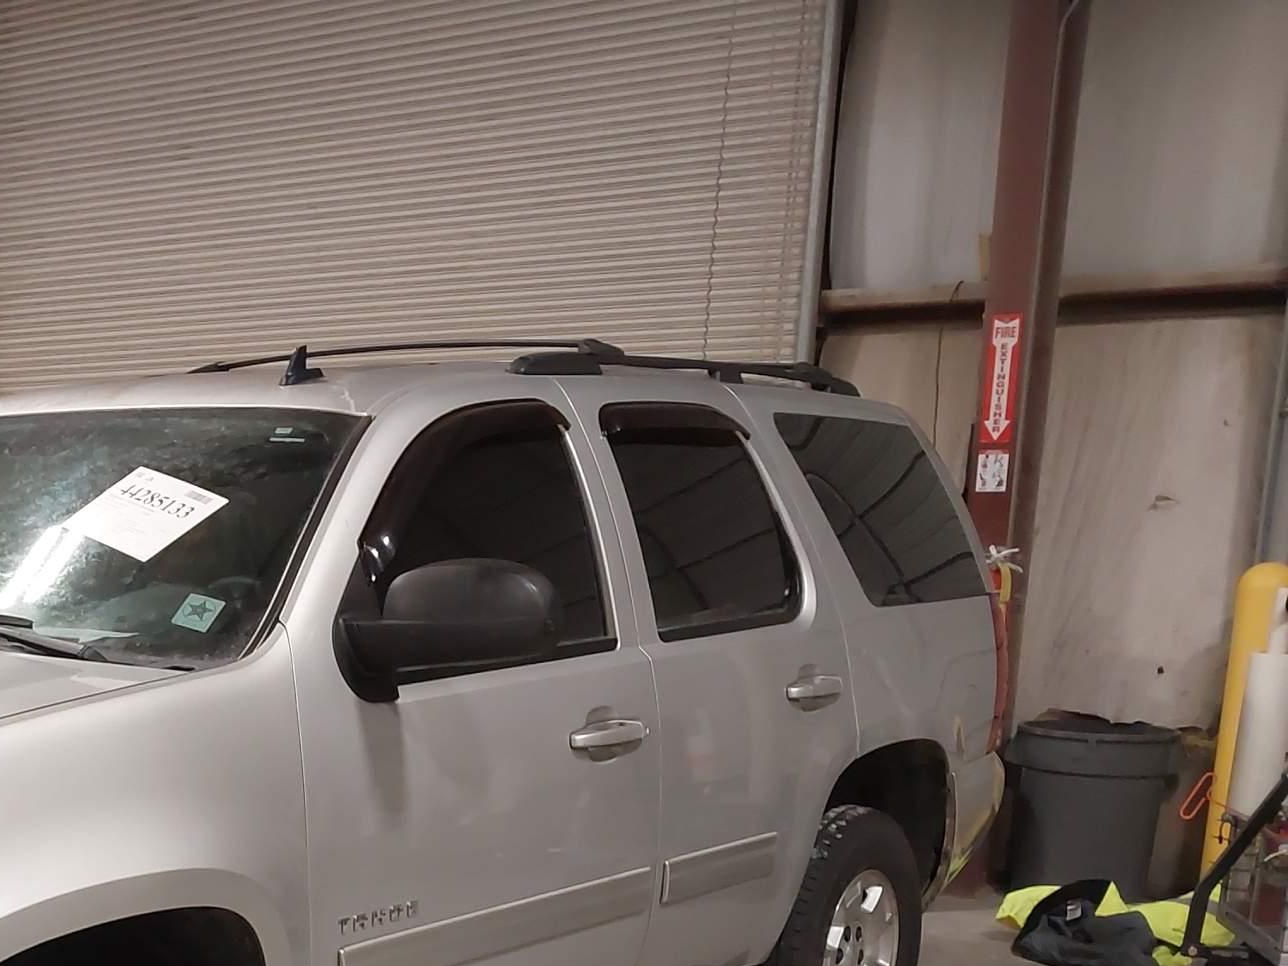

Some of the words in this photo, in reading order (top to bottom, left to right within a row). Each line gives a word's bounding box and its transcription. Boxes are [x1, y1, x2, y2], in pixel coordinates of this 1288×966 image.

[995, 326, 1017, 339] FIRE
[992, 343, 1008, 432] EXTINGUISHER
[120, 484, 196, 519] 44285133
[338, 901, 417, 934] TAHOE
